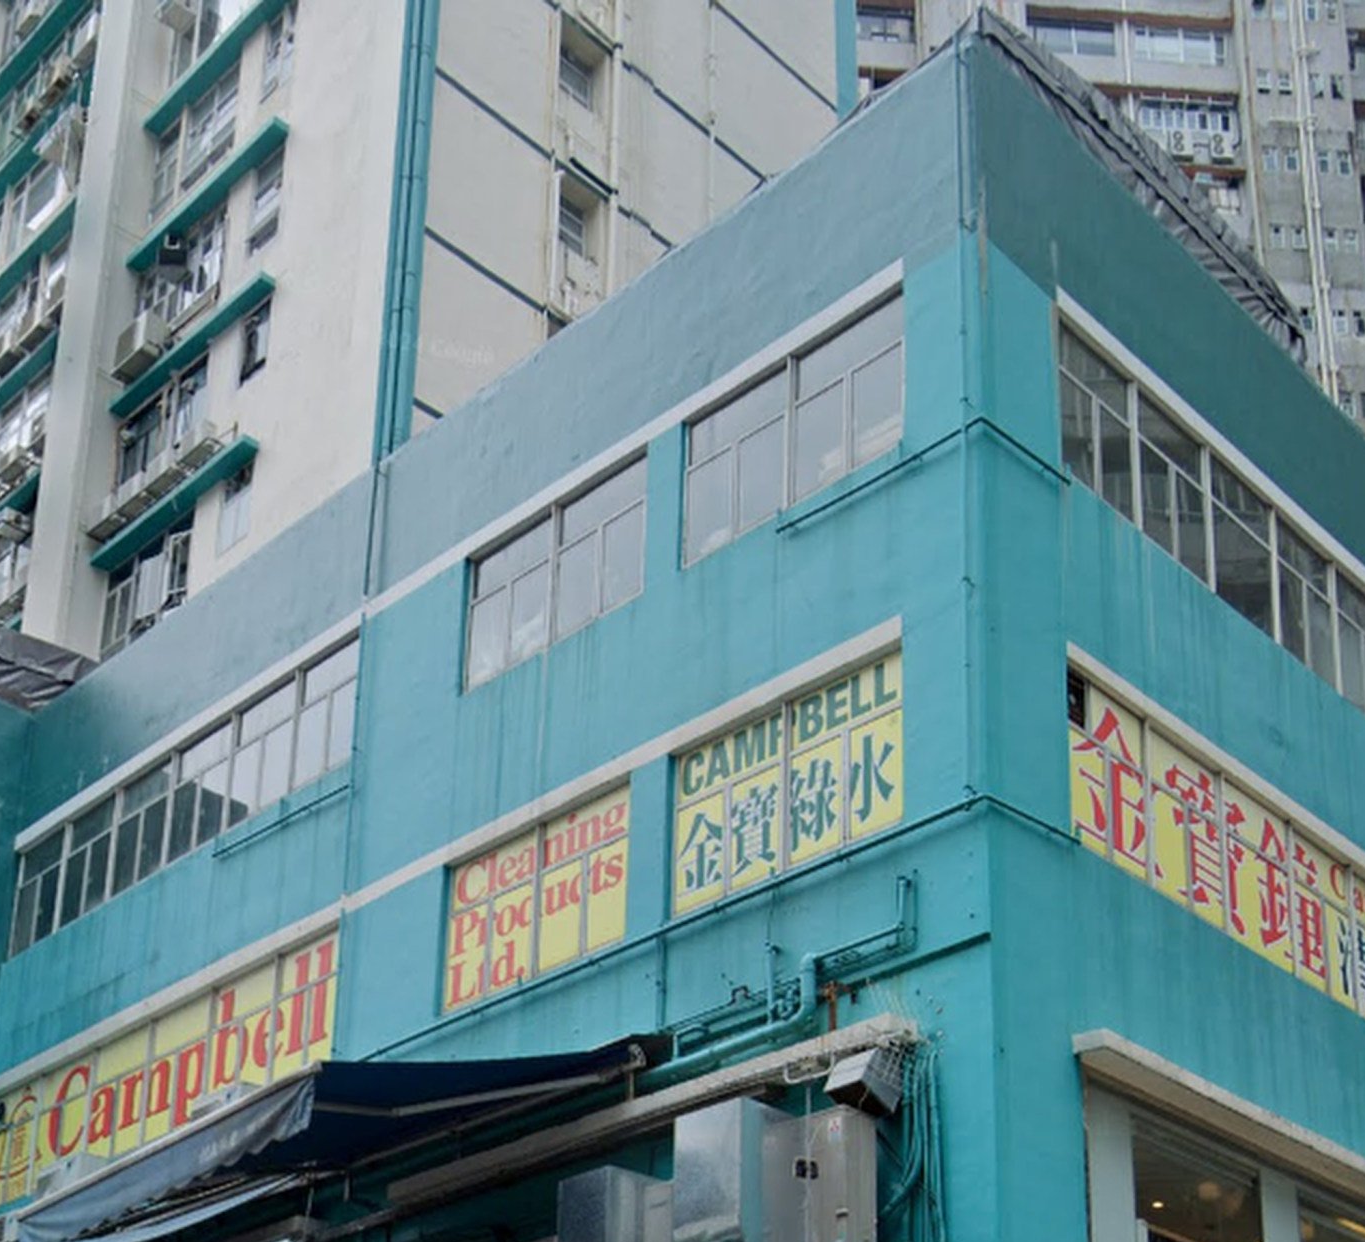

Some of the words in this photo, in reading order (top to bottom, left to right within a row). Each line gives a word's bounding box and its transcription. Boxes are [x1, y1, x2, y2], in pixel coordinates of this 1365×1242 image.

[682, 661, 898, 796] CAMPBELL
[455, 801, 626, 907] Cleaning
[677, 734, 895, 890] 金寶綠水
[451, 850, 625, 958] Products
[446, 941, 526, 1009] Ltd.
[47, 940, 336, 1158] Campbell
